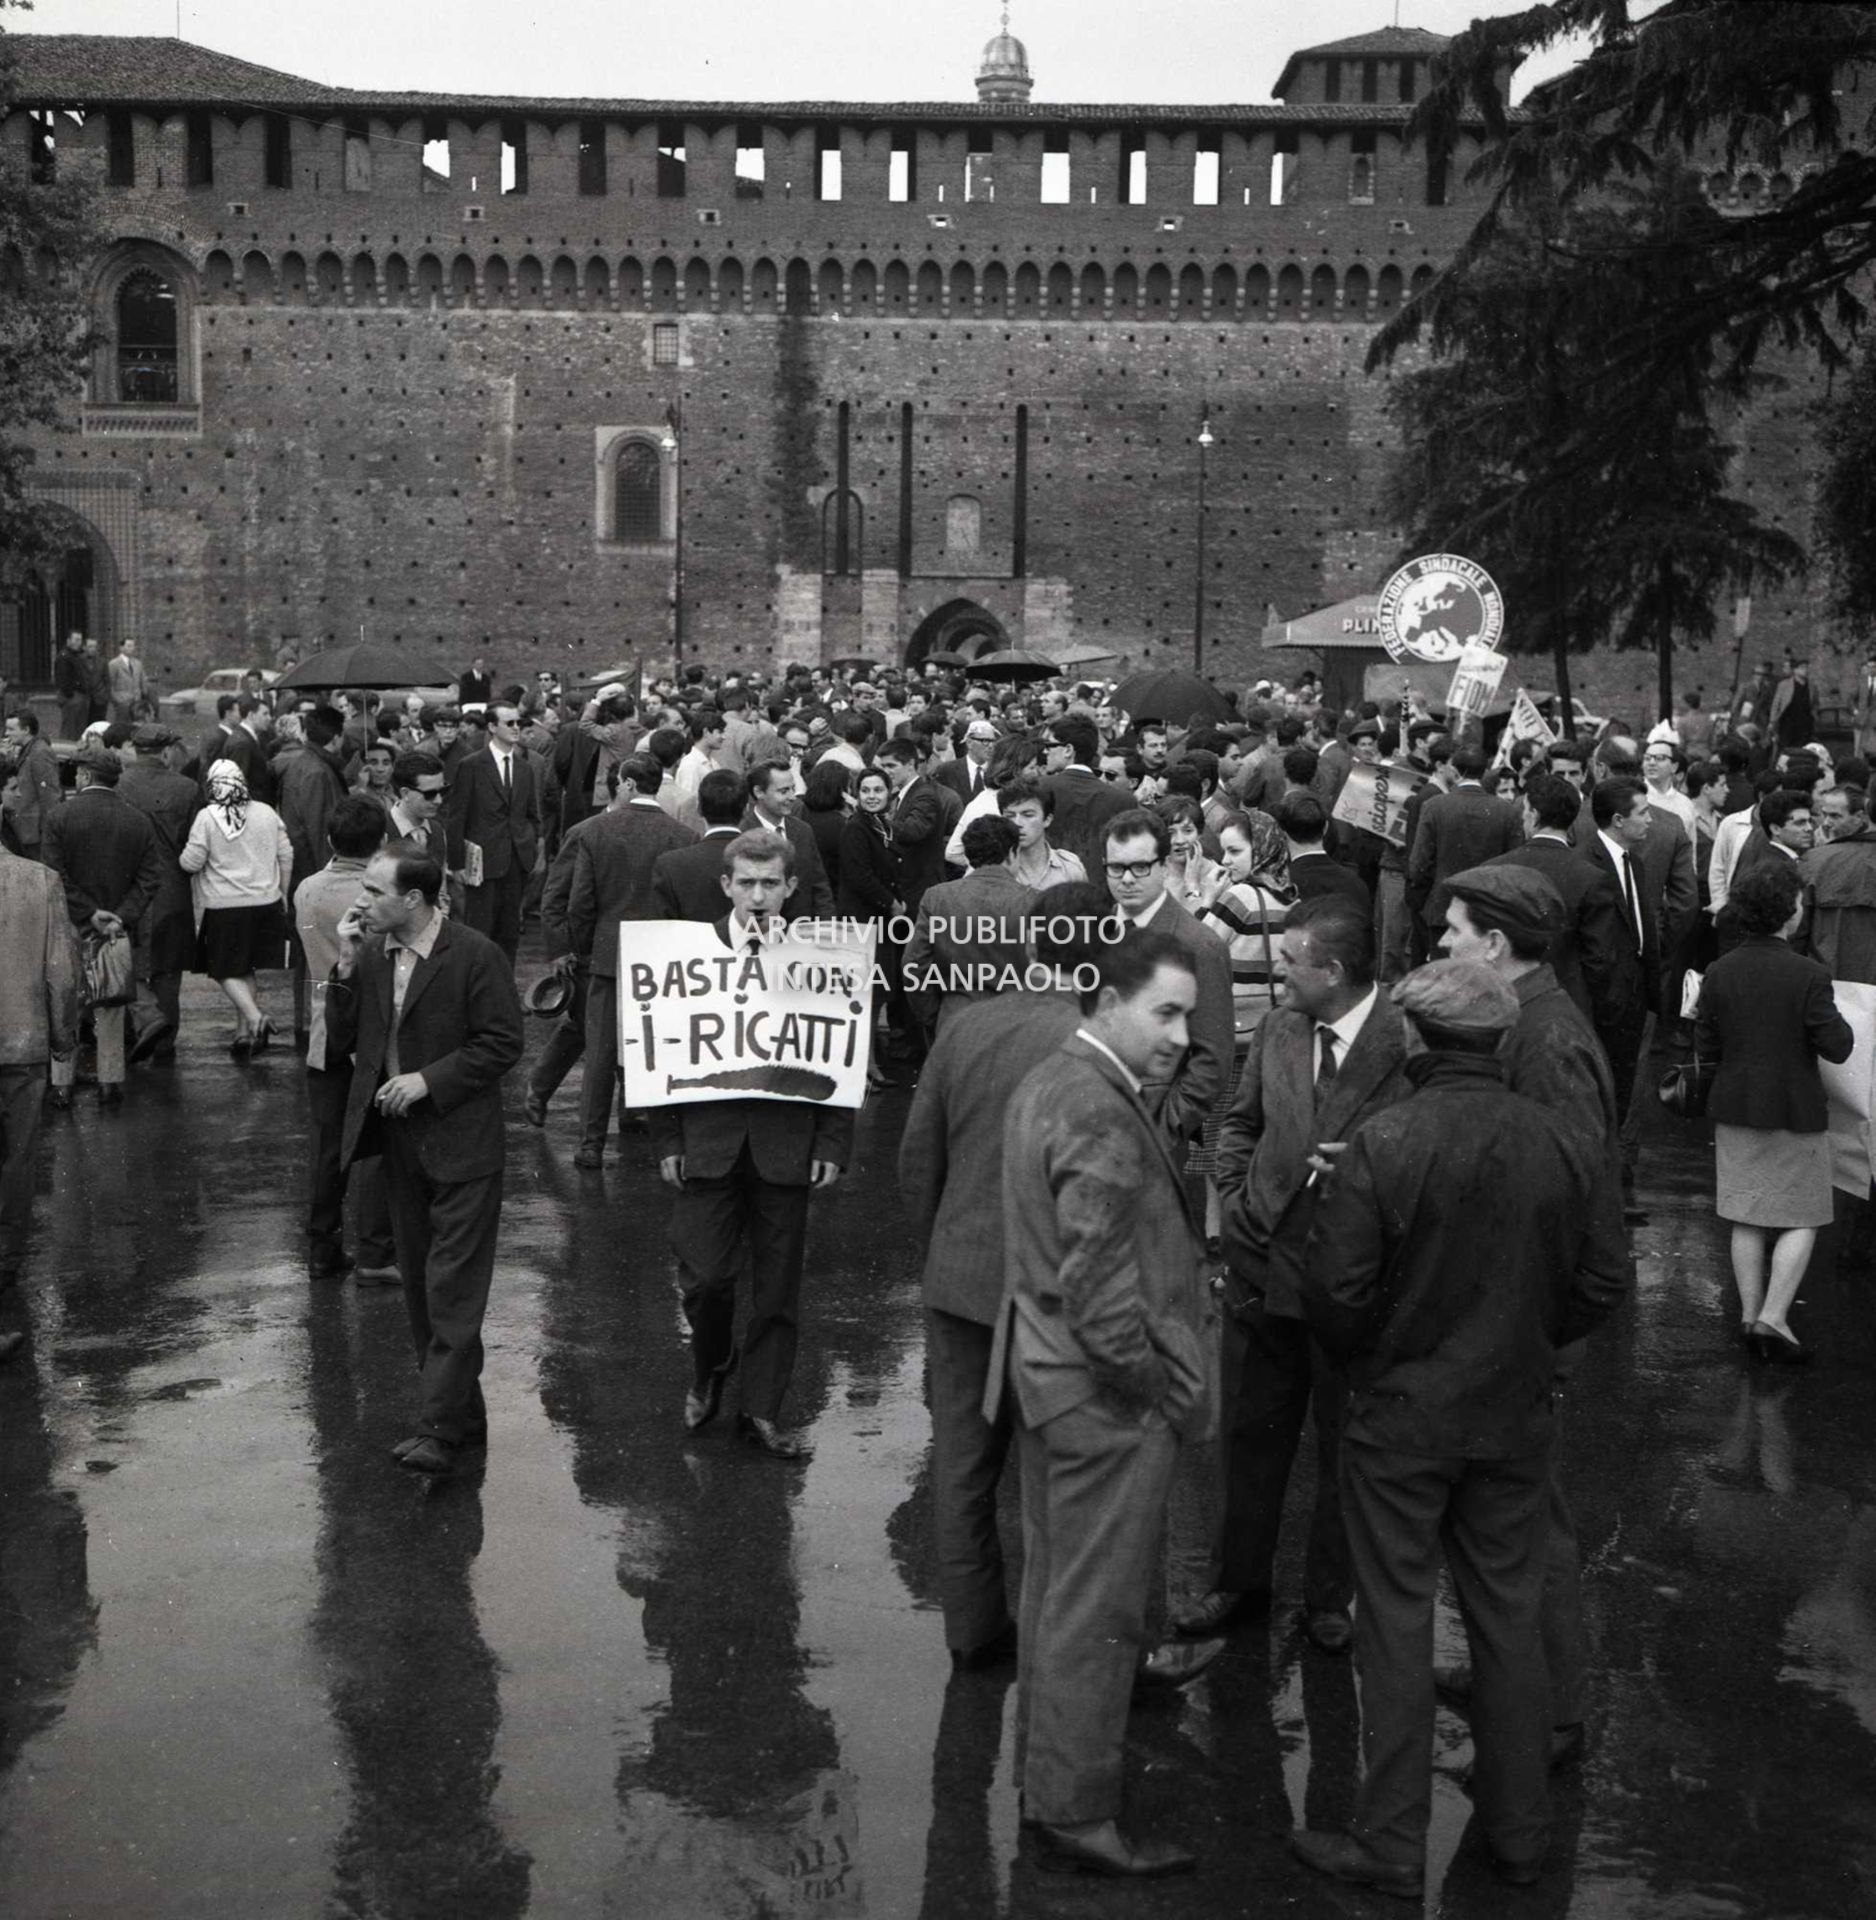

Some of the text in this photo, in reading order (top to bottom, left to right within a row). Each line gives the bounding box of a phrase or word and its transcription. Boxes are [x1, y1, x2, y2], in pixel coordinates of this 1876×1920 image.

[1382, 570, 1414, 657] FEDERAZIONE
[1418, 557, 1488, 589] SINDACALE
[631, 956, 768, 1002] BASTA
[689, 994, 864, 1068] RICATTI
